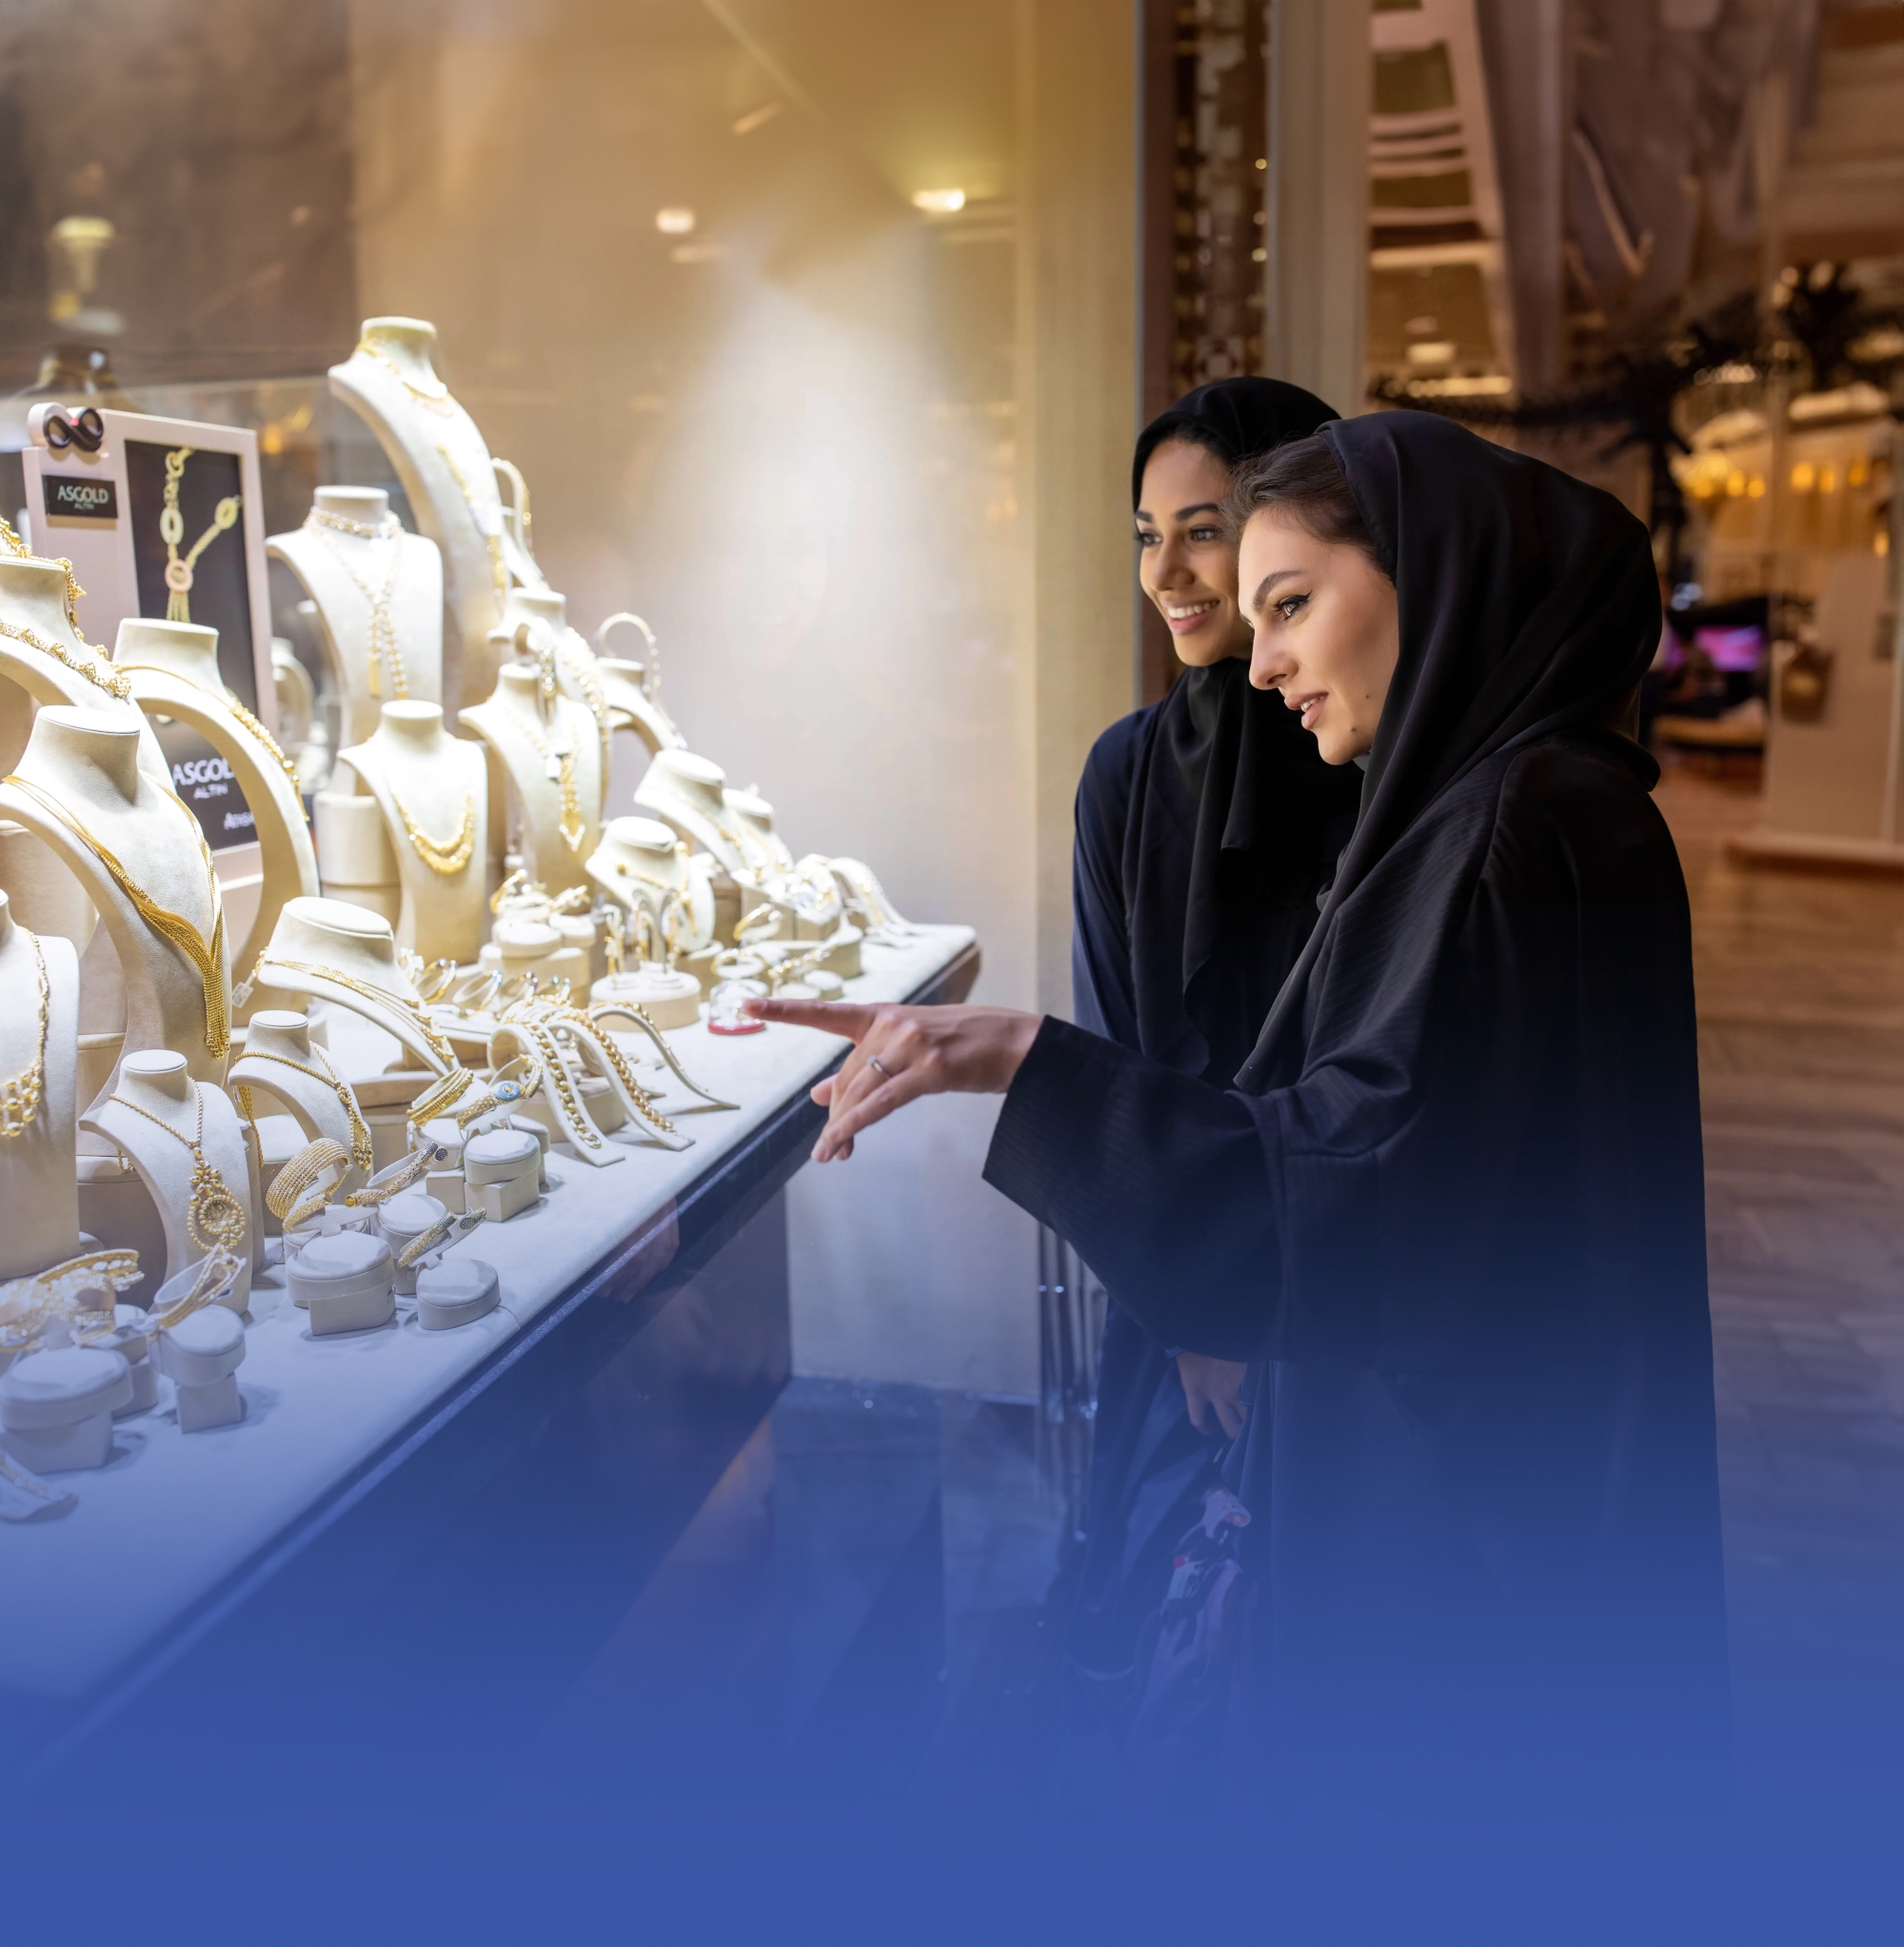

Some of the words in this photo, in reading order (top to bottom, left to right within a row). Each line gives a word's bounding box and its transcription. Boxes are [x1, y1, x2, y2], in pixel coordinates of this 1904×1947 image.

[57, 485, 109, 504] ASGOLD
[172, 757, 235, 786] ASGOL
[193, 783, 228, 800] ALTIN
